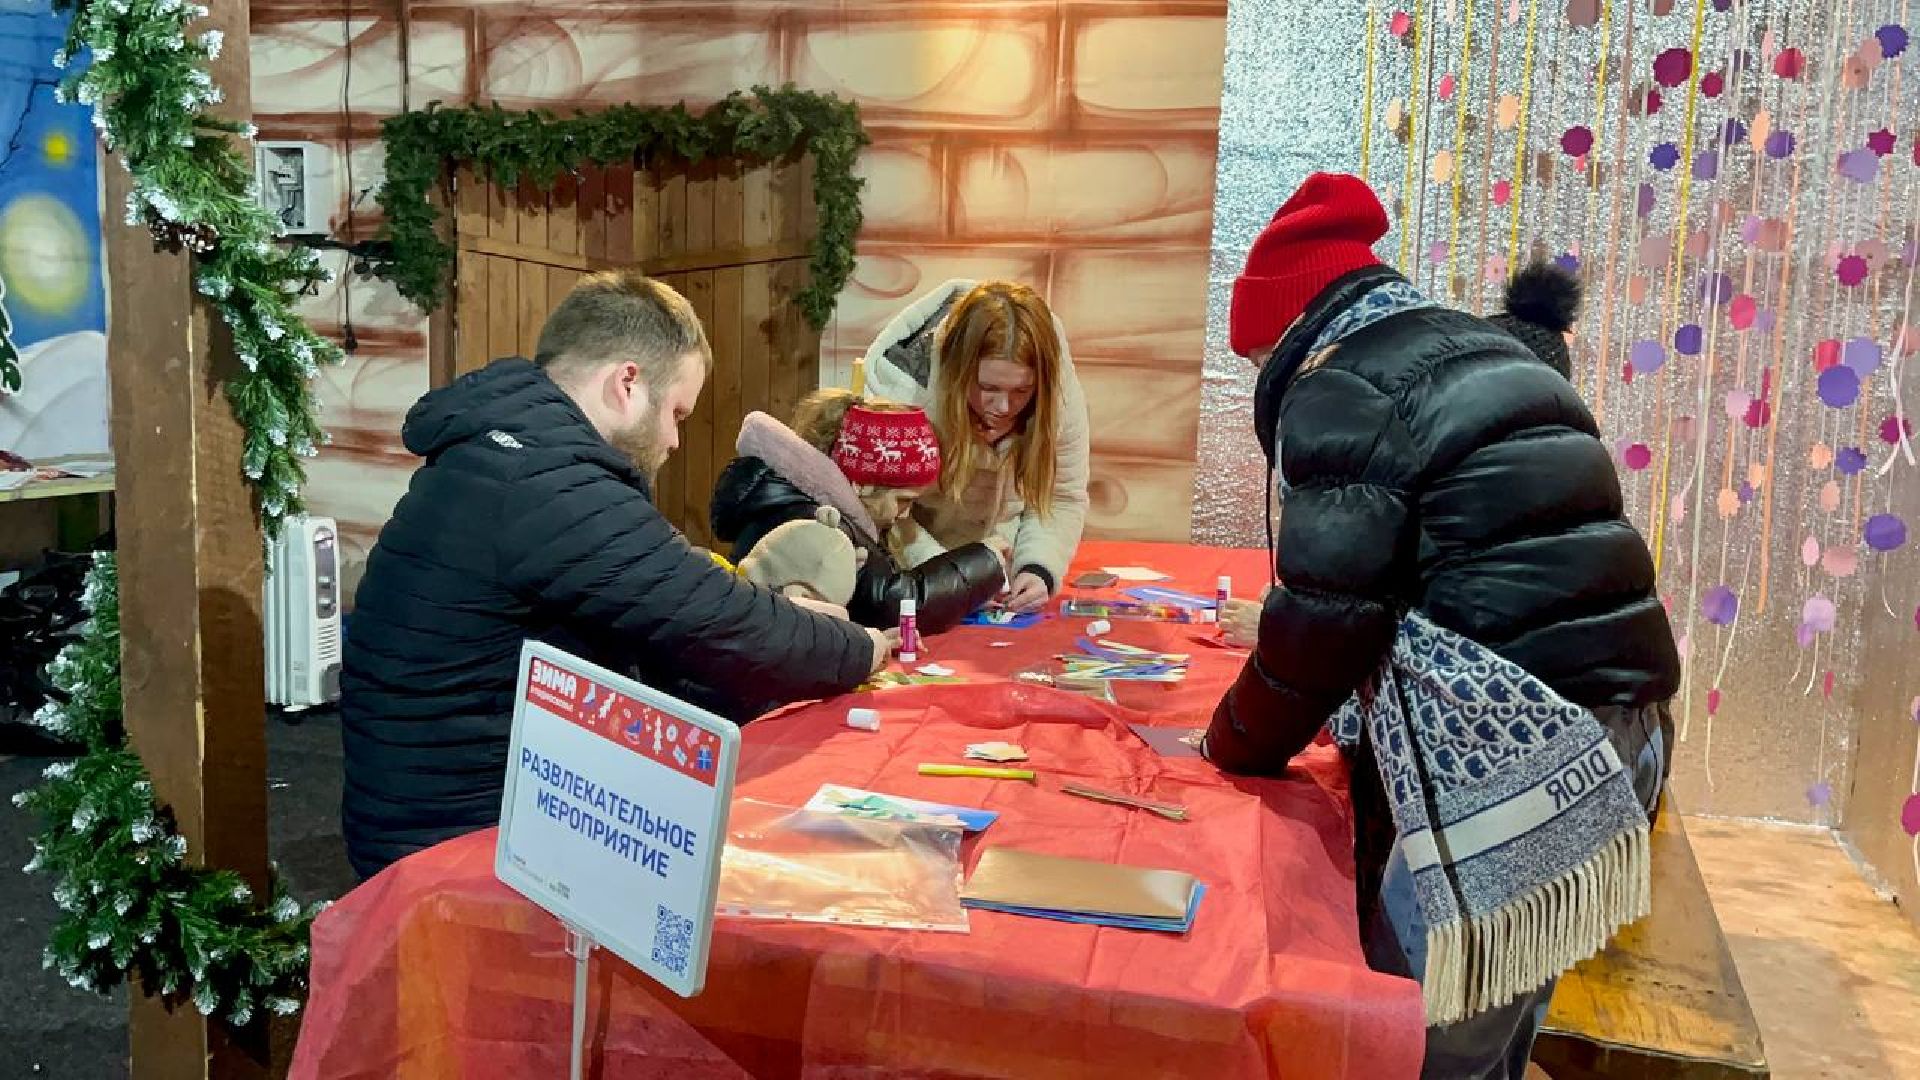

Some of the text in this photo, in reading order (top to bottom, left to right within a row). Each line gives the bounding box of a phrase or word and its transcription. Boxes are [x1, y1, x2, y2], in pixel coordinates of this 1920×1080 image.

[531, 660, 577, 699] ЗИМА
[522, 747, 697, 856] РАЗВЛЕКАТЕЛЬНОЕ
[537, 788, 670, 878] МЕРОПРИЯТИЕ
